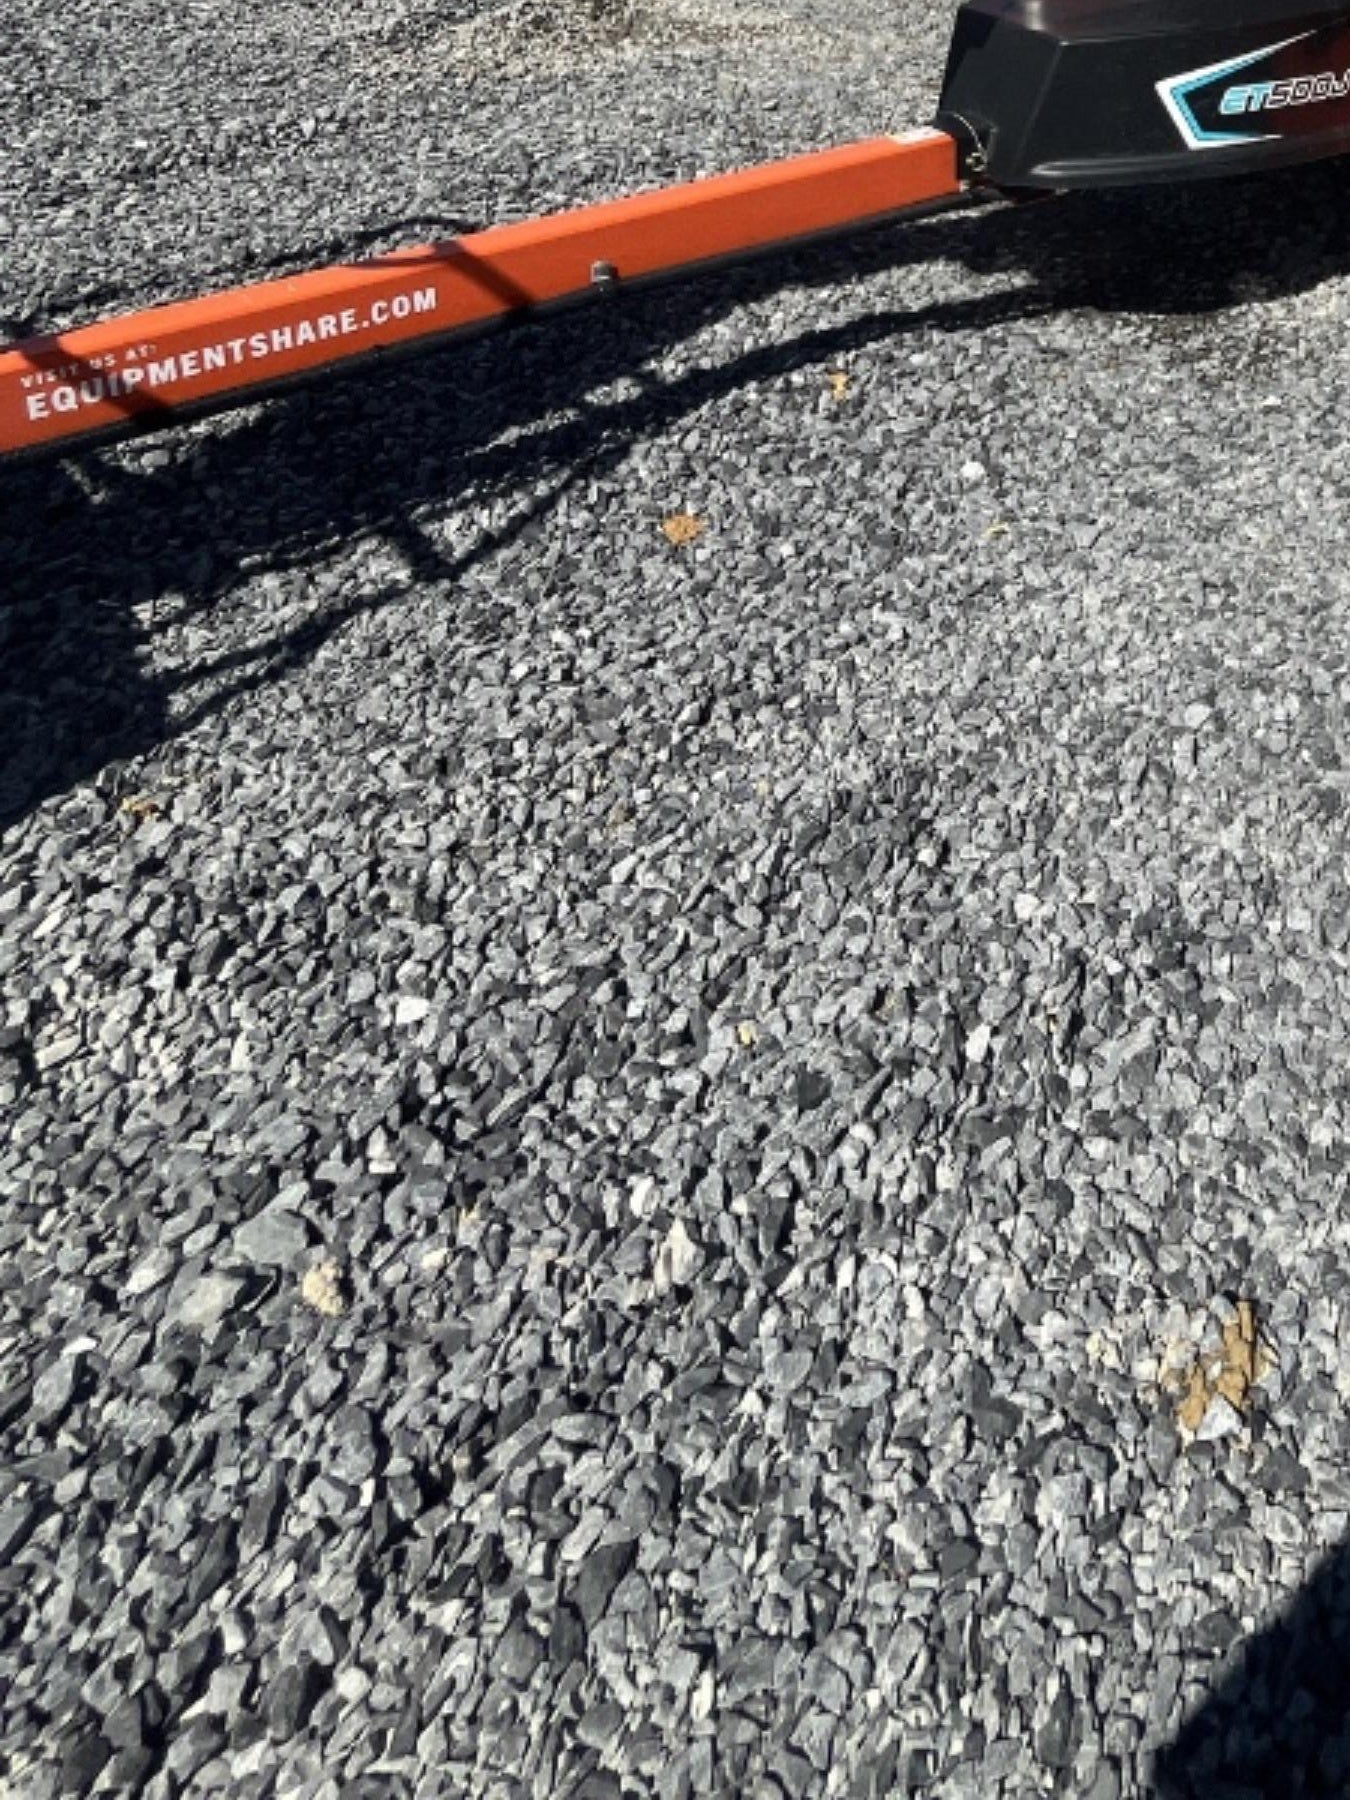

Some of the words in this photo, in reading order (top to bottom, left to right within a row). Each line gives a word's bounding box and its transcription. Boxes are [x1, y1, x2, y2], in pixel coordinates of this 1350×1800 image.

[20, 363, 78, 388] VISIT
[89, 353, 116, 370] US
[26, 287, 437, 421] EQUIPMENTSHARE.COM
